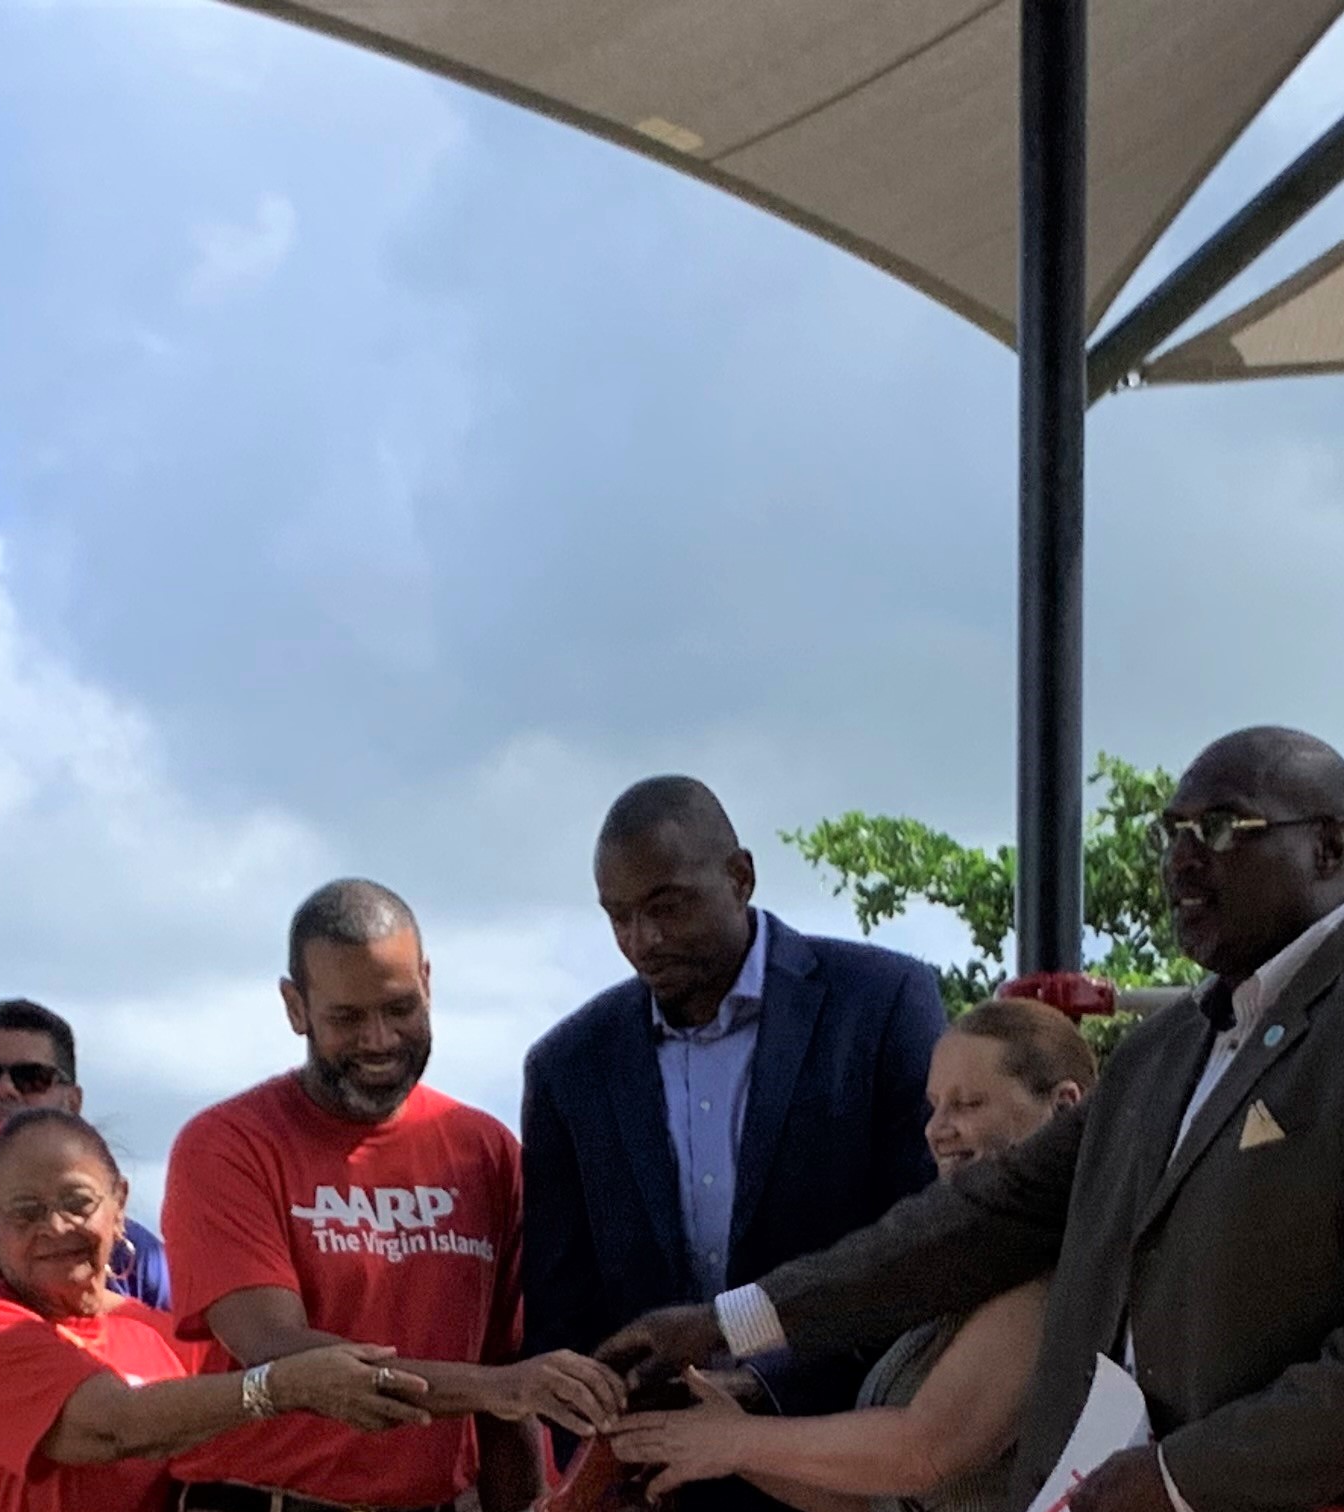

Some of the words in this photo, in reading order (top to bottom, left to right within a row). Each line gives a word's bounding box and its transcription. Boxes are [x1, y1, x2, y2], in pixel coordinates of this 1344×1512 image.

[290, 1184, 455, 1232] AARP
[312, 1228, 361, 1253] The
[362, 1230, 427, 1263] Virgin
[429, 1228, 494, 1262] Islands
